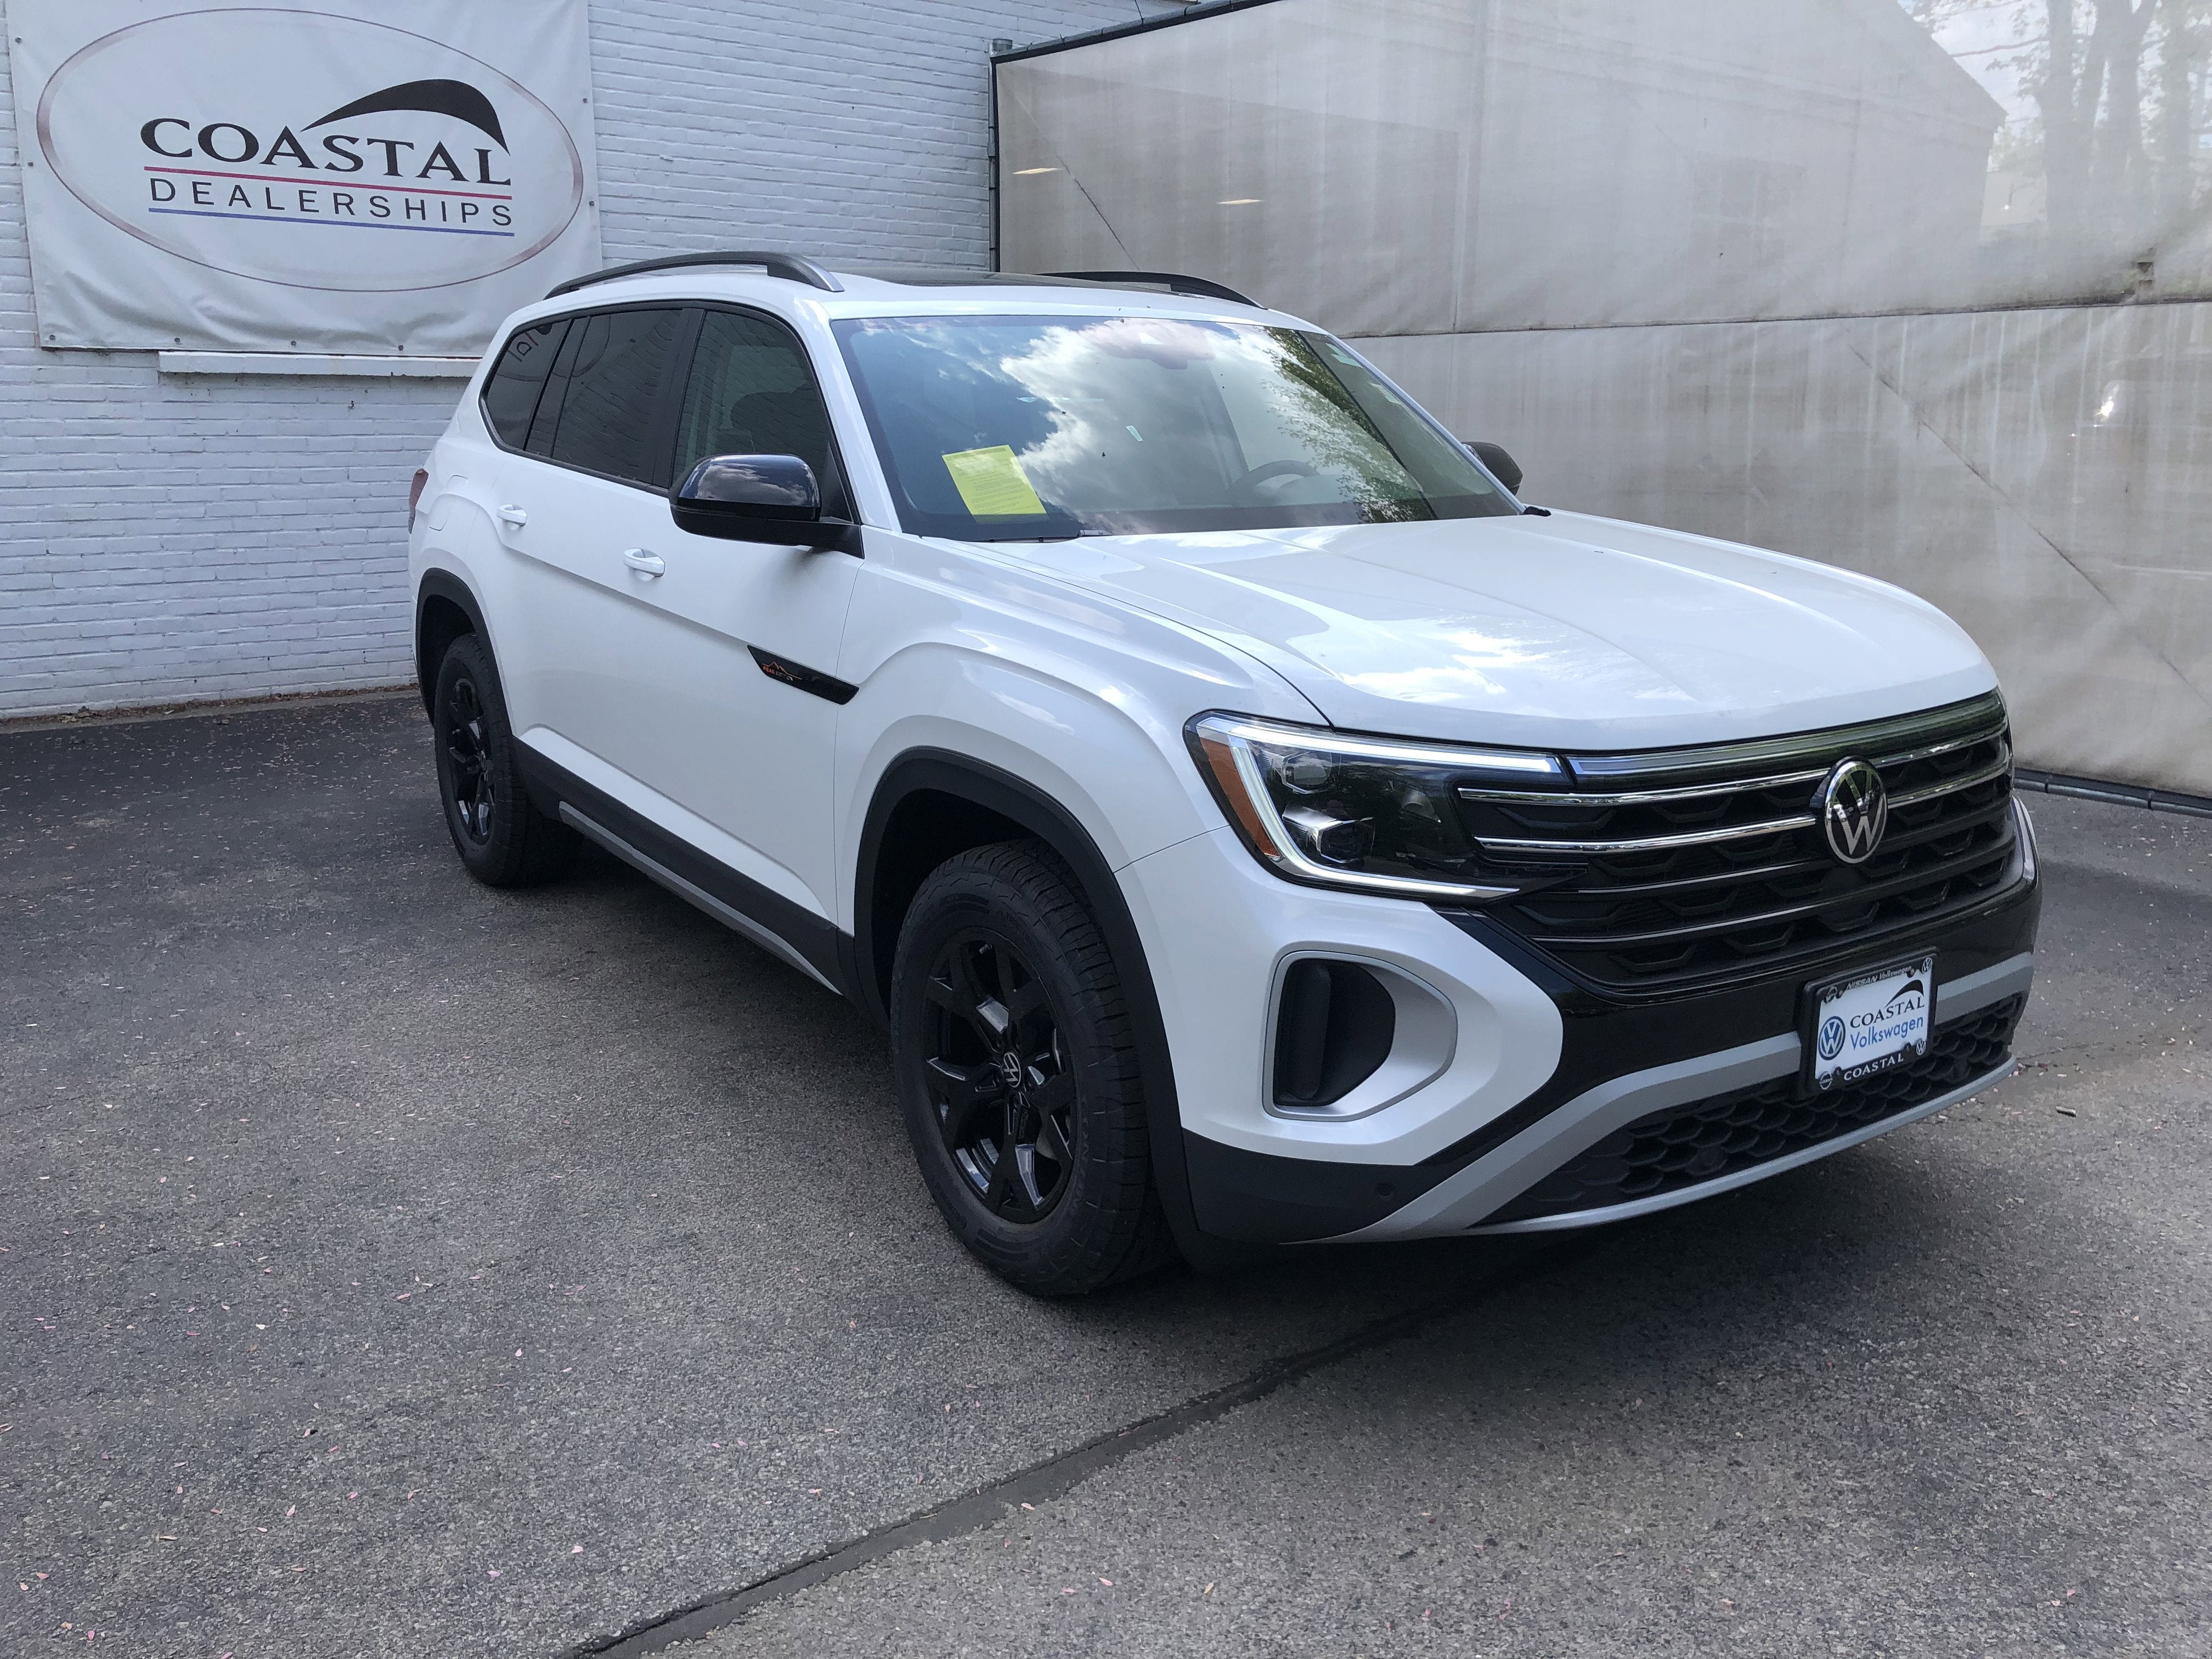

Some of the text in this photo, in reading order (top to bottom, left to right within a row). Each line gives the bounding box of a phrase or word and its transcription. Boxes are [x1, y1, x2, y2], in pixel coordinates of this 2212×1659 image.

[140, 118, 511, 186] COASTAL
[151, 178, 512, 226] DEALERSHIPS
[1846, 974, 1878, 990] NISSAN
[1850, 997, 1925, 1029] COASTAL
[1850, 1016, 1923, 1050] Volkswagen
[1843, 1053, 1904, 1081] COASTAL
